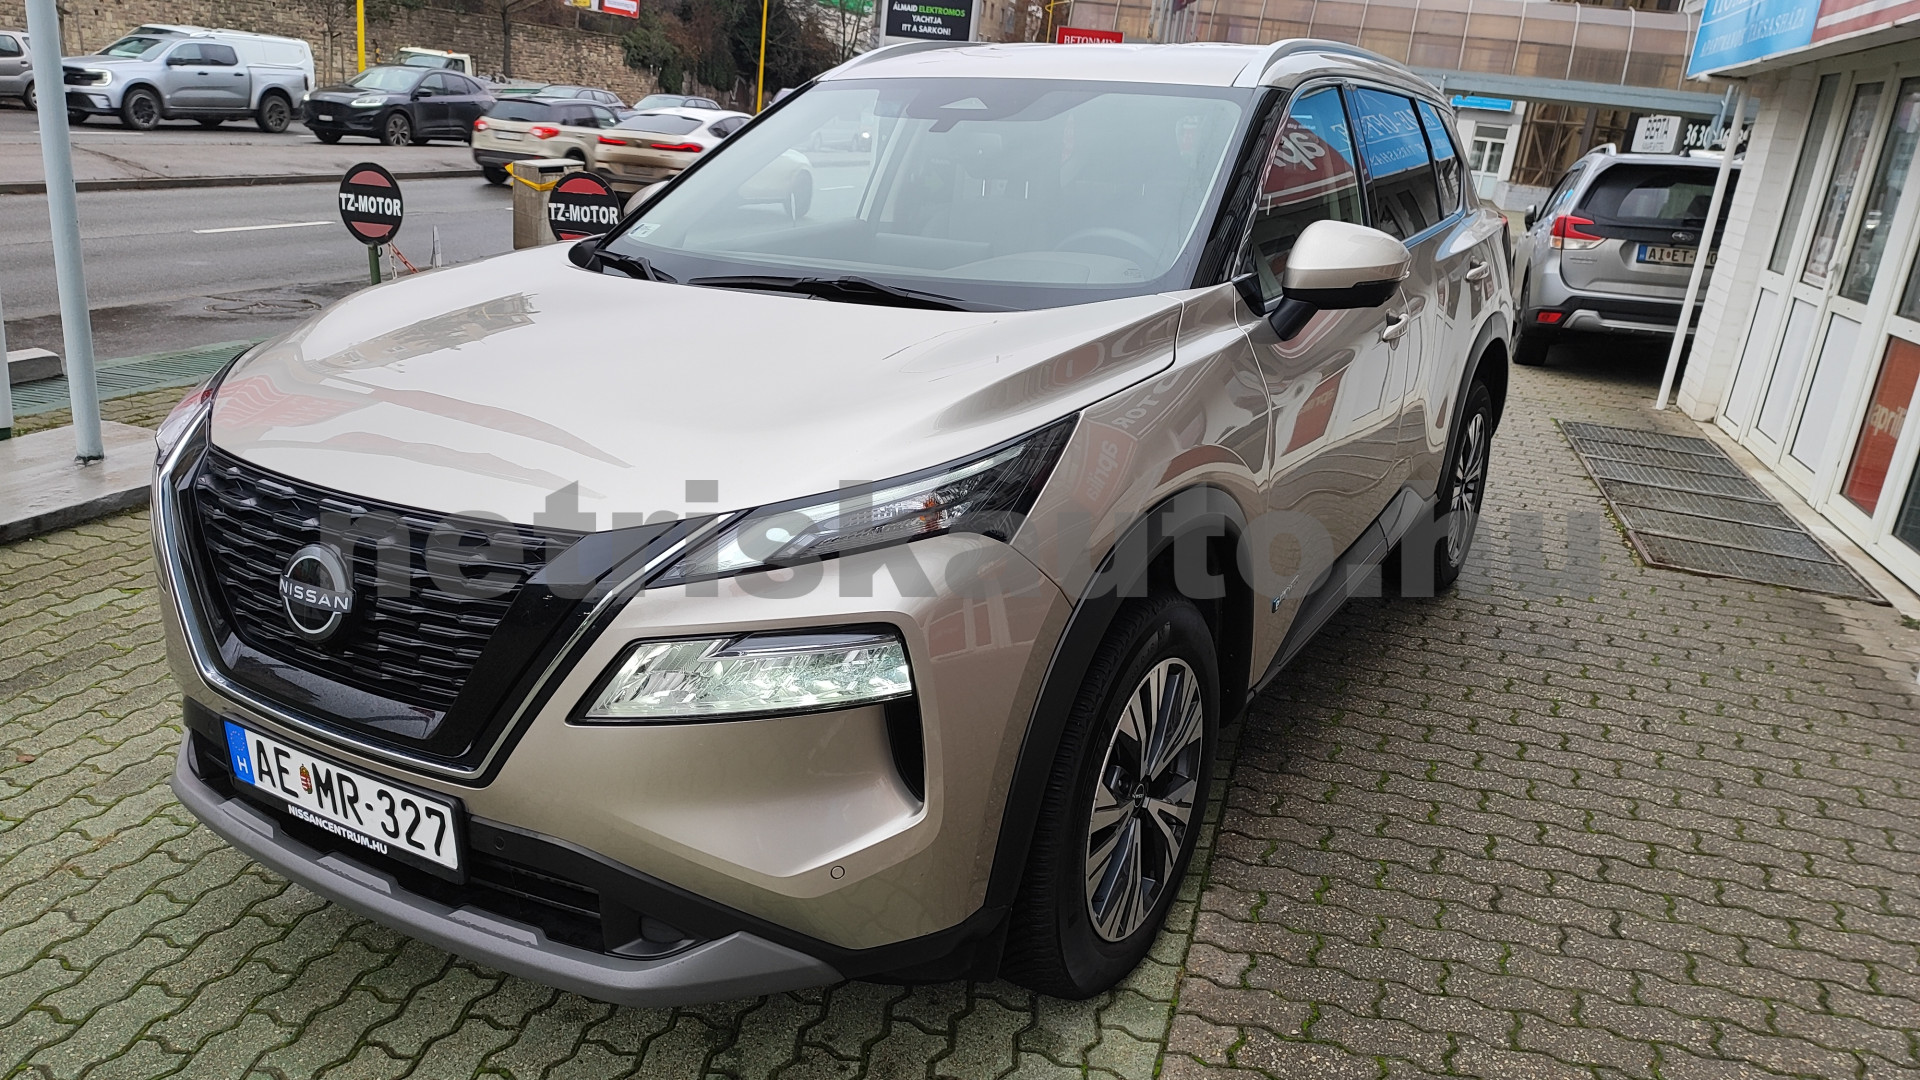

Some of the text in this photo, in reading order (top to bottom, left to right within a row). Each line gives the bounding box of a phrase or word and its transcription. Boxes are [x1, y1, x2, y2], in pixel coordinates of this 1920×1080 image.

[893, 2, 966, 17] ÁLMAID ELEKTROMOS
[912, 14, 942, 25] YACHTJA
[902, 23, 951, 36] ITT A SARKON!
[339, 192, 402, 217] TZ-MOTOR
[548, 202, 619, 225] TZ-MOTOR
[279, 577, 349, 610] NISSAN
[236, 754, 249, 775] H
[256, 739, 447, 857] AE MR-327
[288, 804, 388, 855] NISSANCENTRUM.HU
